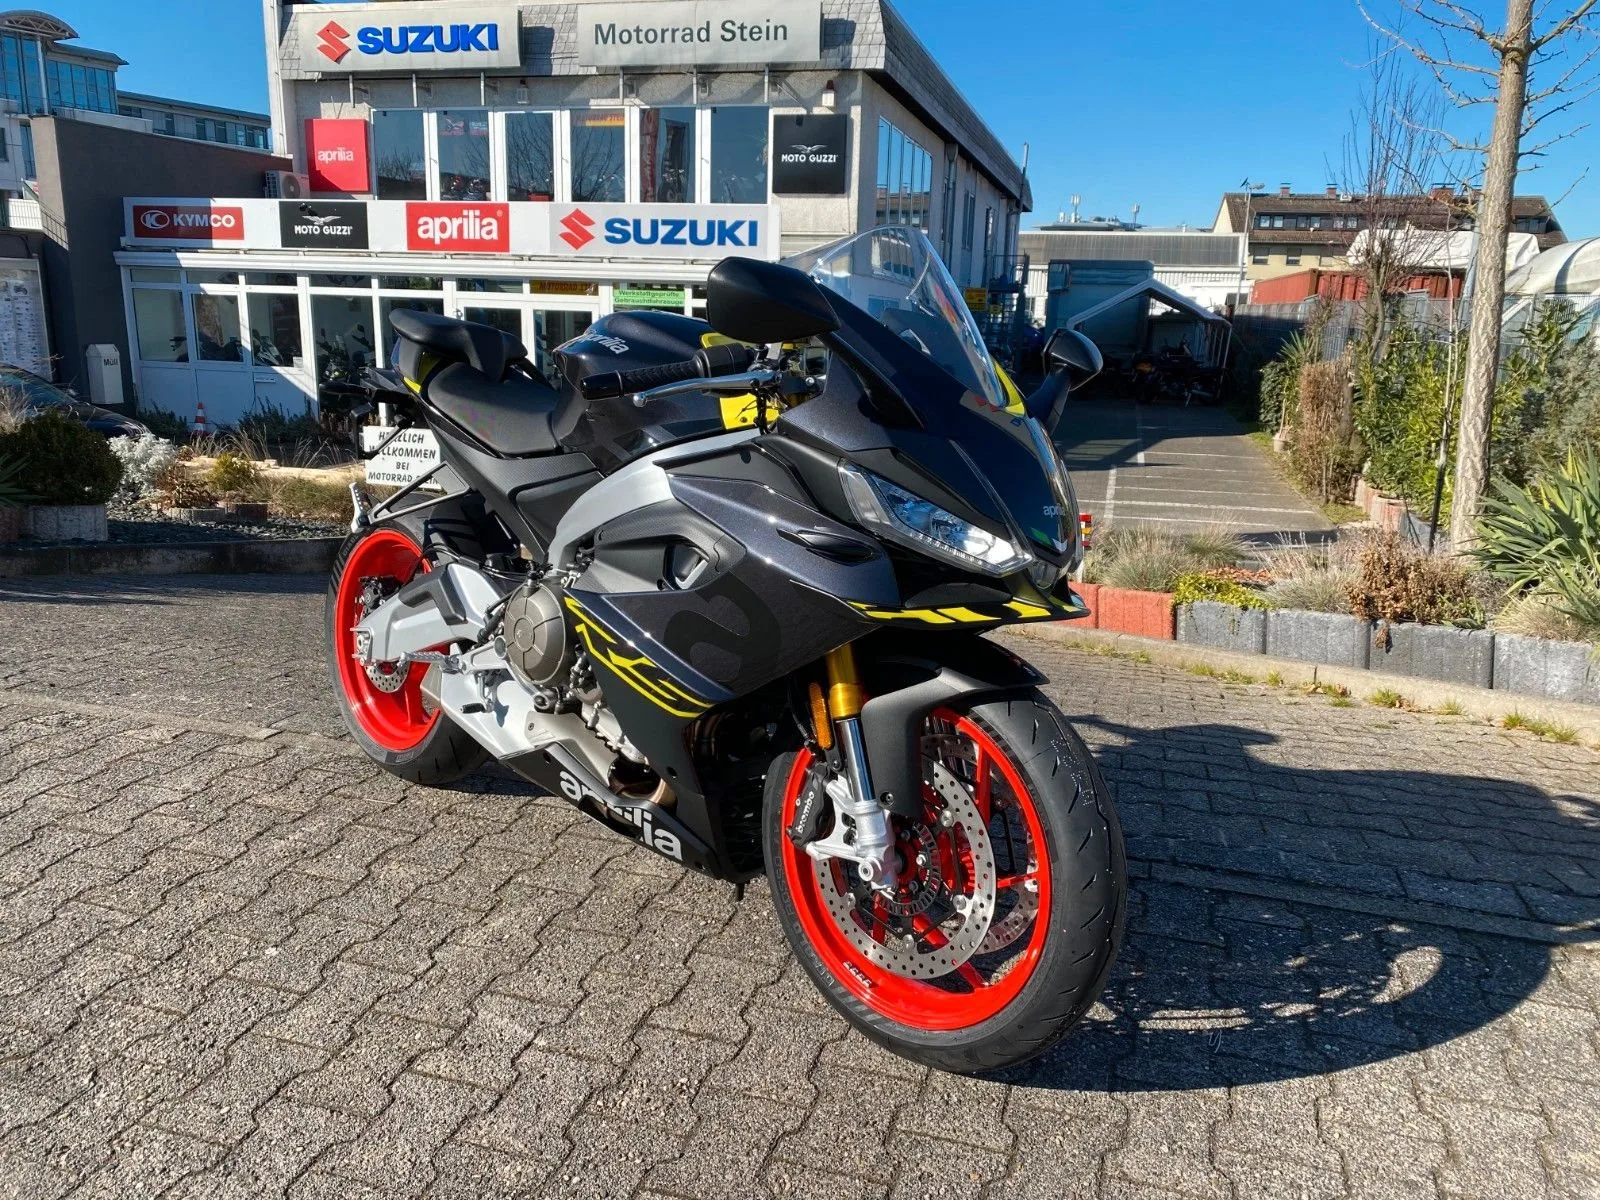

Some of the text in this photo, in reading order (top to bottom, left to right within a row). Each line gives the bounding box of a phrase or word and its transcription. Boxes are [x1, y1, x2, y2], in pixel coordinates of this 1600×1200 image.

[357, 23, 499, 55] SUZUKI
[594, 19, 788, 45] Motorrad Stein
[318, 147, 354, 164] aprilia
[781, 154, 837, 163] MOTO GUZZI
[173, 213, 236, 228] KYMCO
[417, 209, 499, 244] aprilia
[294, 224, 352, 236] MOTO GUZZI
[604, 217, 758, 247] SUZUKI
[378, 431, 425, 444] HZLICH
[369, 445, 436, 459] LLKOMMEN
[395, 461, 409, 471] BEI
[368, 471, 413, 483] MOTORRAD
[795, 791, 815, 834] brembo
